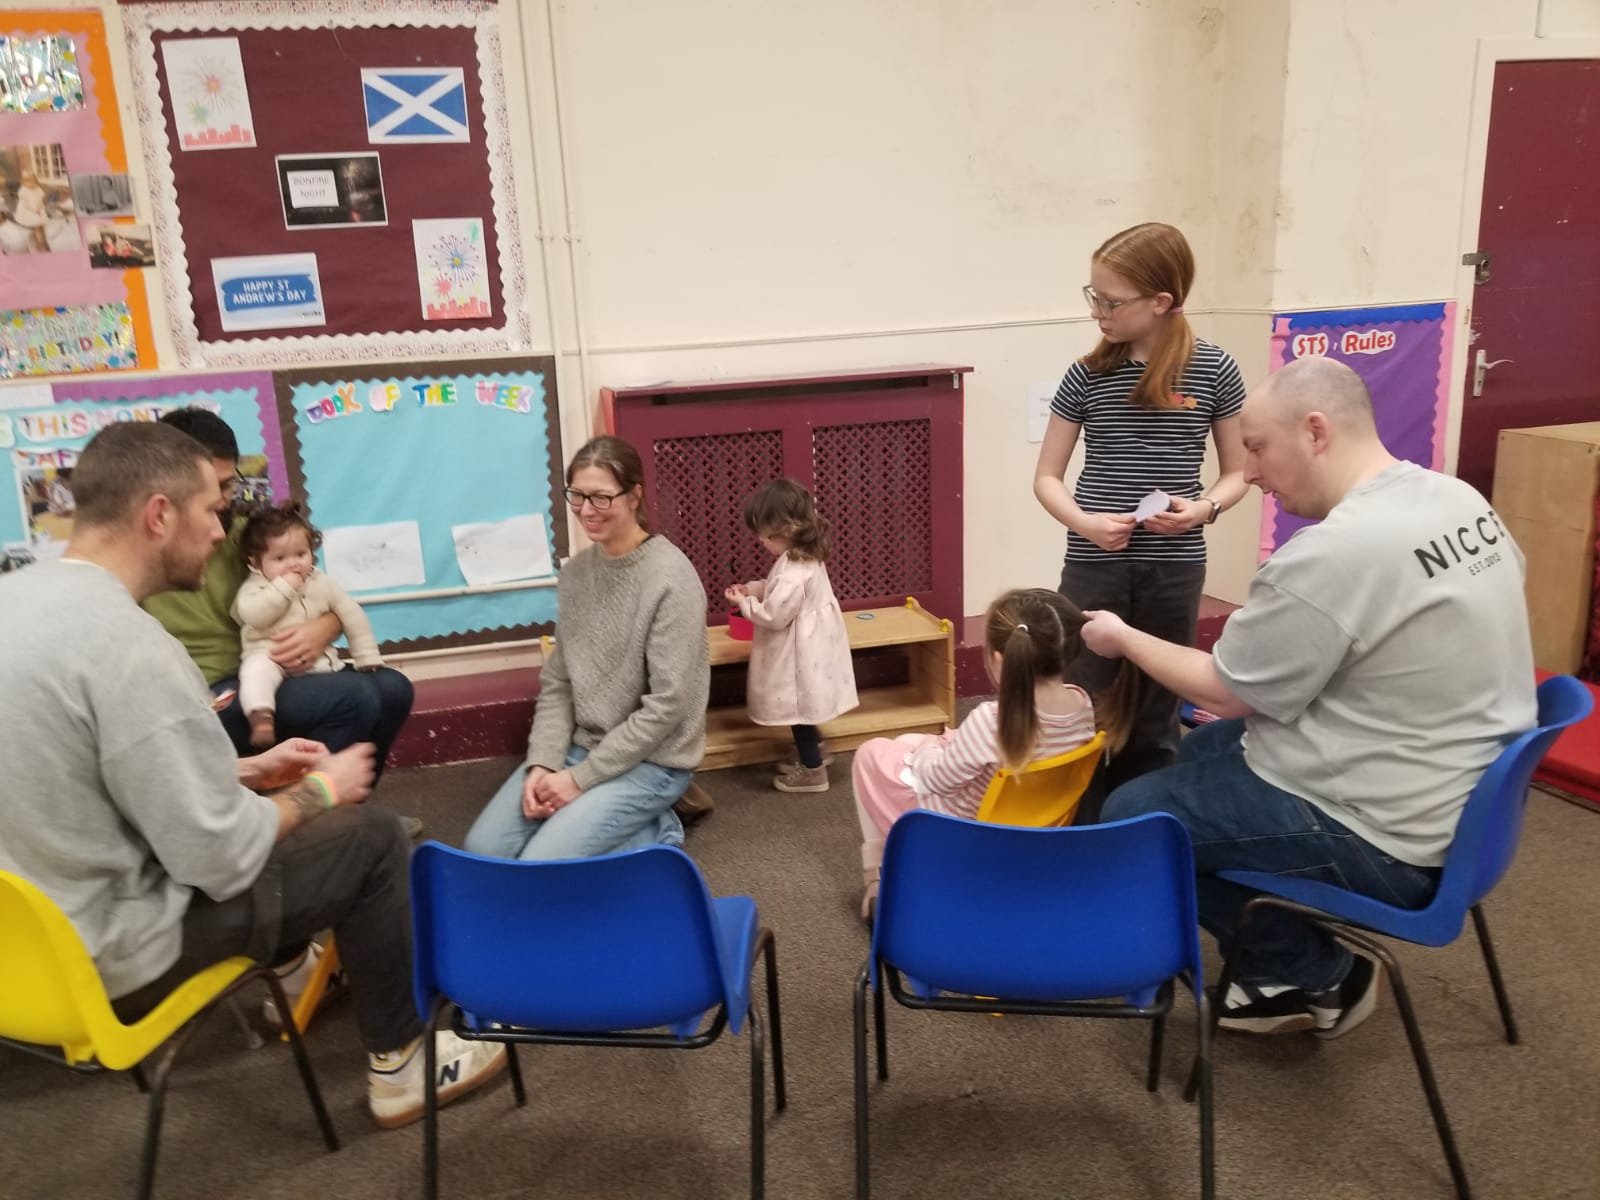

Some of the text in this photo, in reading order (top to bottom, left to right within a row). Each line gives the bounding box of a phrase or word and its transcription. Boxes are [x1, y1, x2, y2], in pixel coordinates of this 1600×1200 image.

[232, 289, 307, 305] ANDREW'S DAY
[242, 279, 291, 293] HAPPY ST
[1297, 331, 1394, 357] STS Rules
[306, 379, 532, 422] BOOK OF THE WEEK
[22, 412, 89, 437] THIS
[96, 406, 172, 428] MONT
